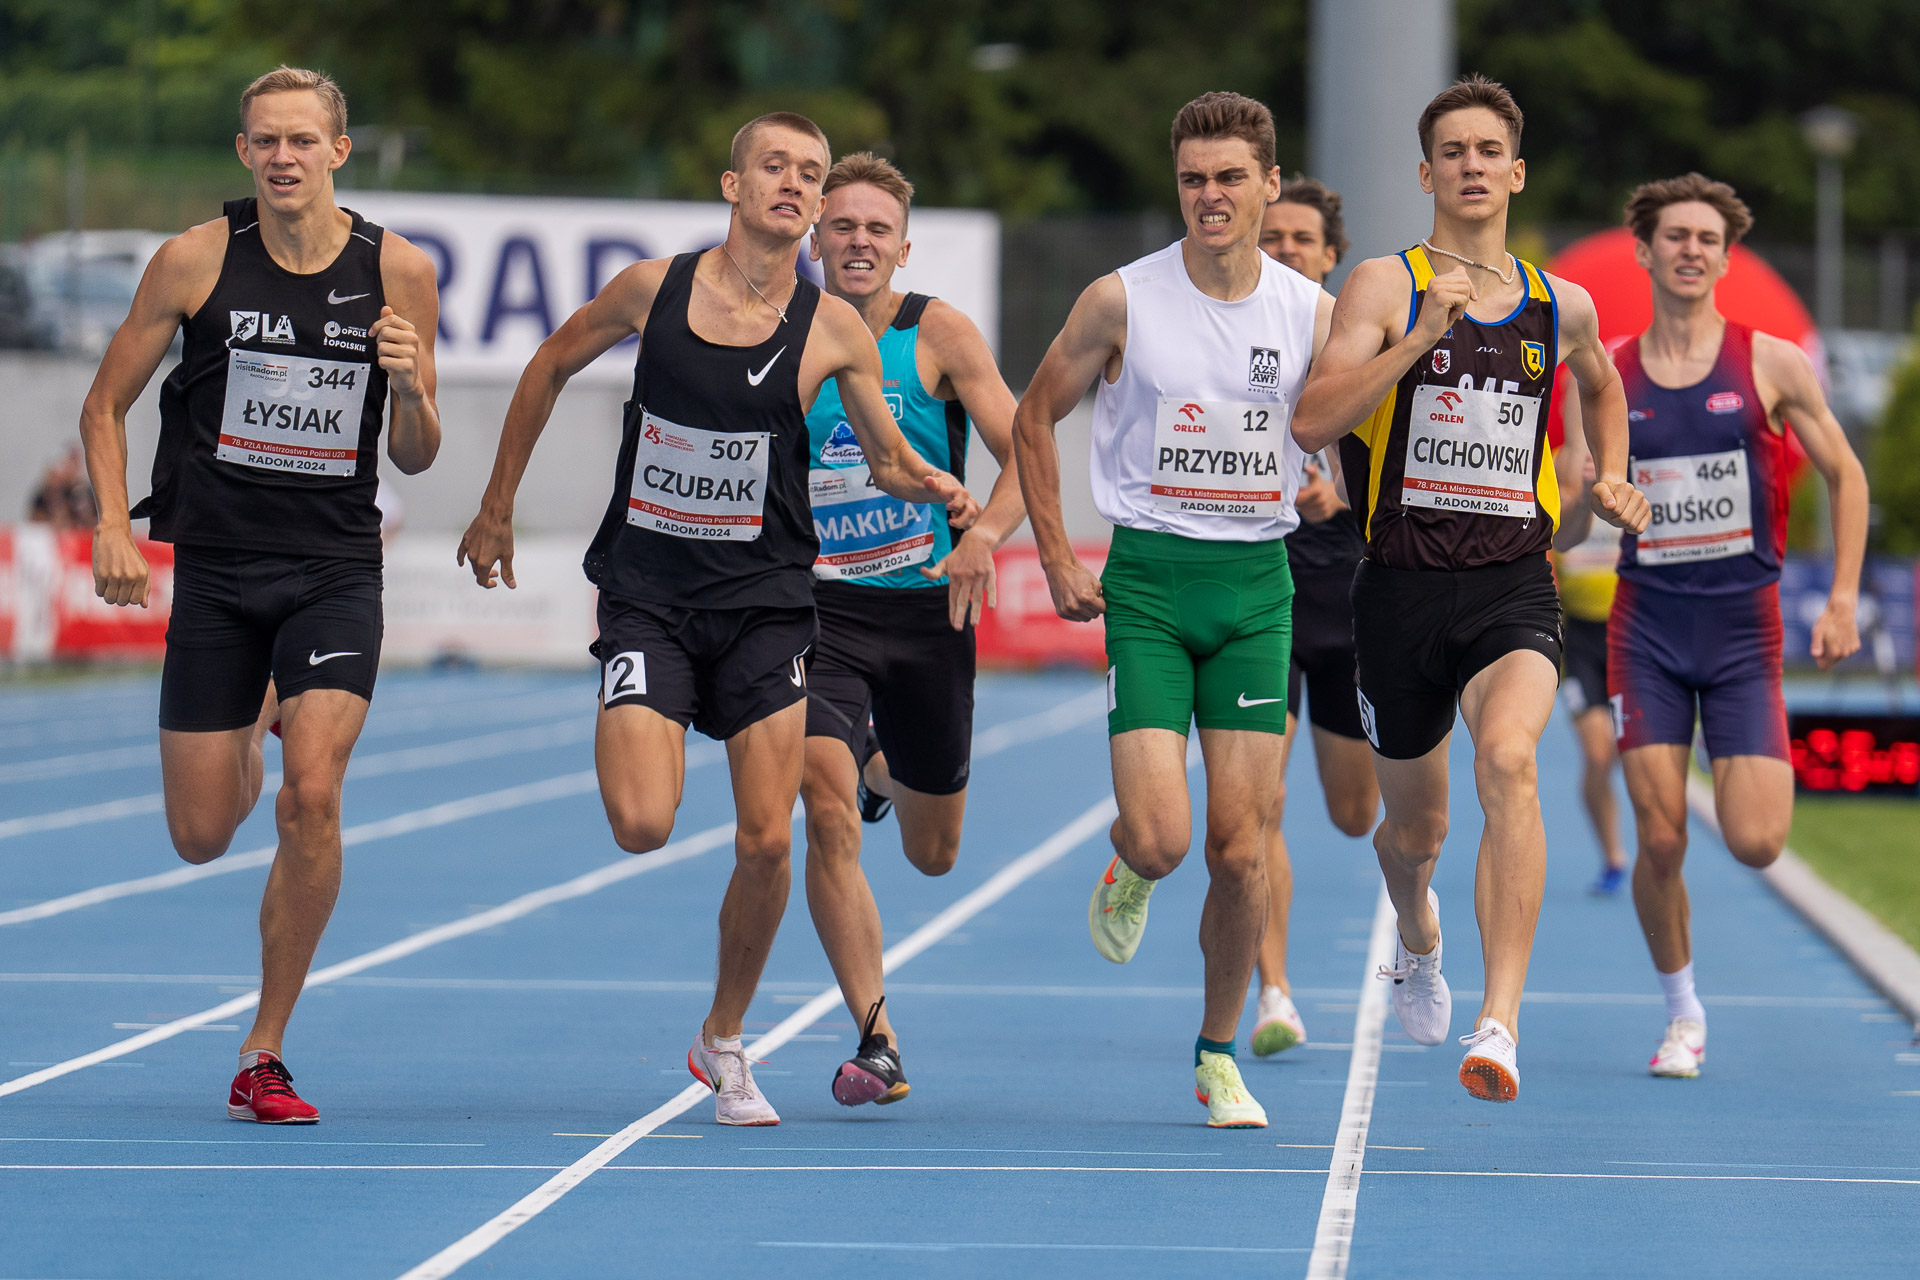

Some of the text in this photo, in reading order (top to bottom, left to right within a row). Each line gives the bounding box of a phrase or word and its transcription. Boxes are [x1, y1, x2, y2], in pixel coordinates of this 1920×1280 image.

[262, 313, 295, 339] LA
[341, 328, 367, 338] OPOLE
[328, 339, 367, 352] OPOLSKIE
[235, 363, 288, 378] visitRadom.pl
[307, 367, 356, 391] 344
[1251, 373, 1277, 384] AWF
[1252, 364, 1277, 375] AZS
[242, 399, 344, 435] ŁYSIAK
[1243, 410, 1269, 432] 12
[1429, 412, 1464, 424] ORLEN
[1497, 401, 1524, 427] 50
[1173, 423, 1206, 433] ORLEN
[231, 437, 346, 459] 78. PZLA Mistrzostwa Polski U20
[709, 439, 759, 462] 507
[1413, 436, 1530, 475] CICHOWSKI
[248, 453, 326, 472] RADOM 2024
[1158, 447, 1278, 476] PRZYBYŁA
[1697, 459, 1737, 481] 464
[643, 464, 757, 502] CZUBAK
[1175, 488, 1193, 497] PZLA
[1194, 491, 1238, 499] Mistrzostwa
[1260, 492, 1272, 500] U20
[1416, 480, 1524, 500] 78. PZLA Mistrzostwa Polski U20
[641, 502, 751, 524] 78. PZLA Mistrzostwa Polski U20
[1180, 501, 1256, 514] RADOM 2024
[1434, 496, 1509, 513] RADOM 2024
[1651, 495, 1733, 526] BUŚKO
[655, 519, 731, 537] RADOM 2024
[814, 502, 922, 544] MAKIŁA
[840, 553, 911, 577] RADOM 2024
[611, 656, 636, 697] 2
[1361, 694, 1372, 736] 5
